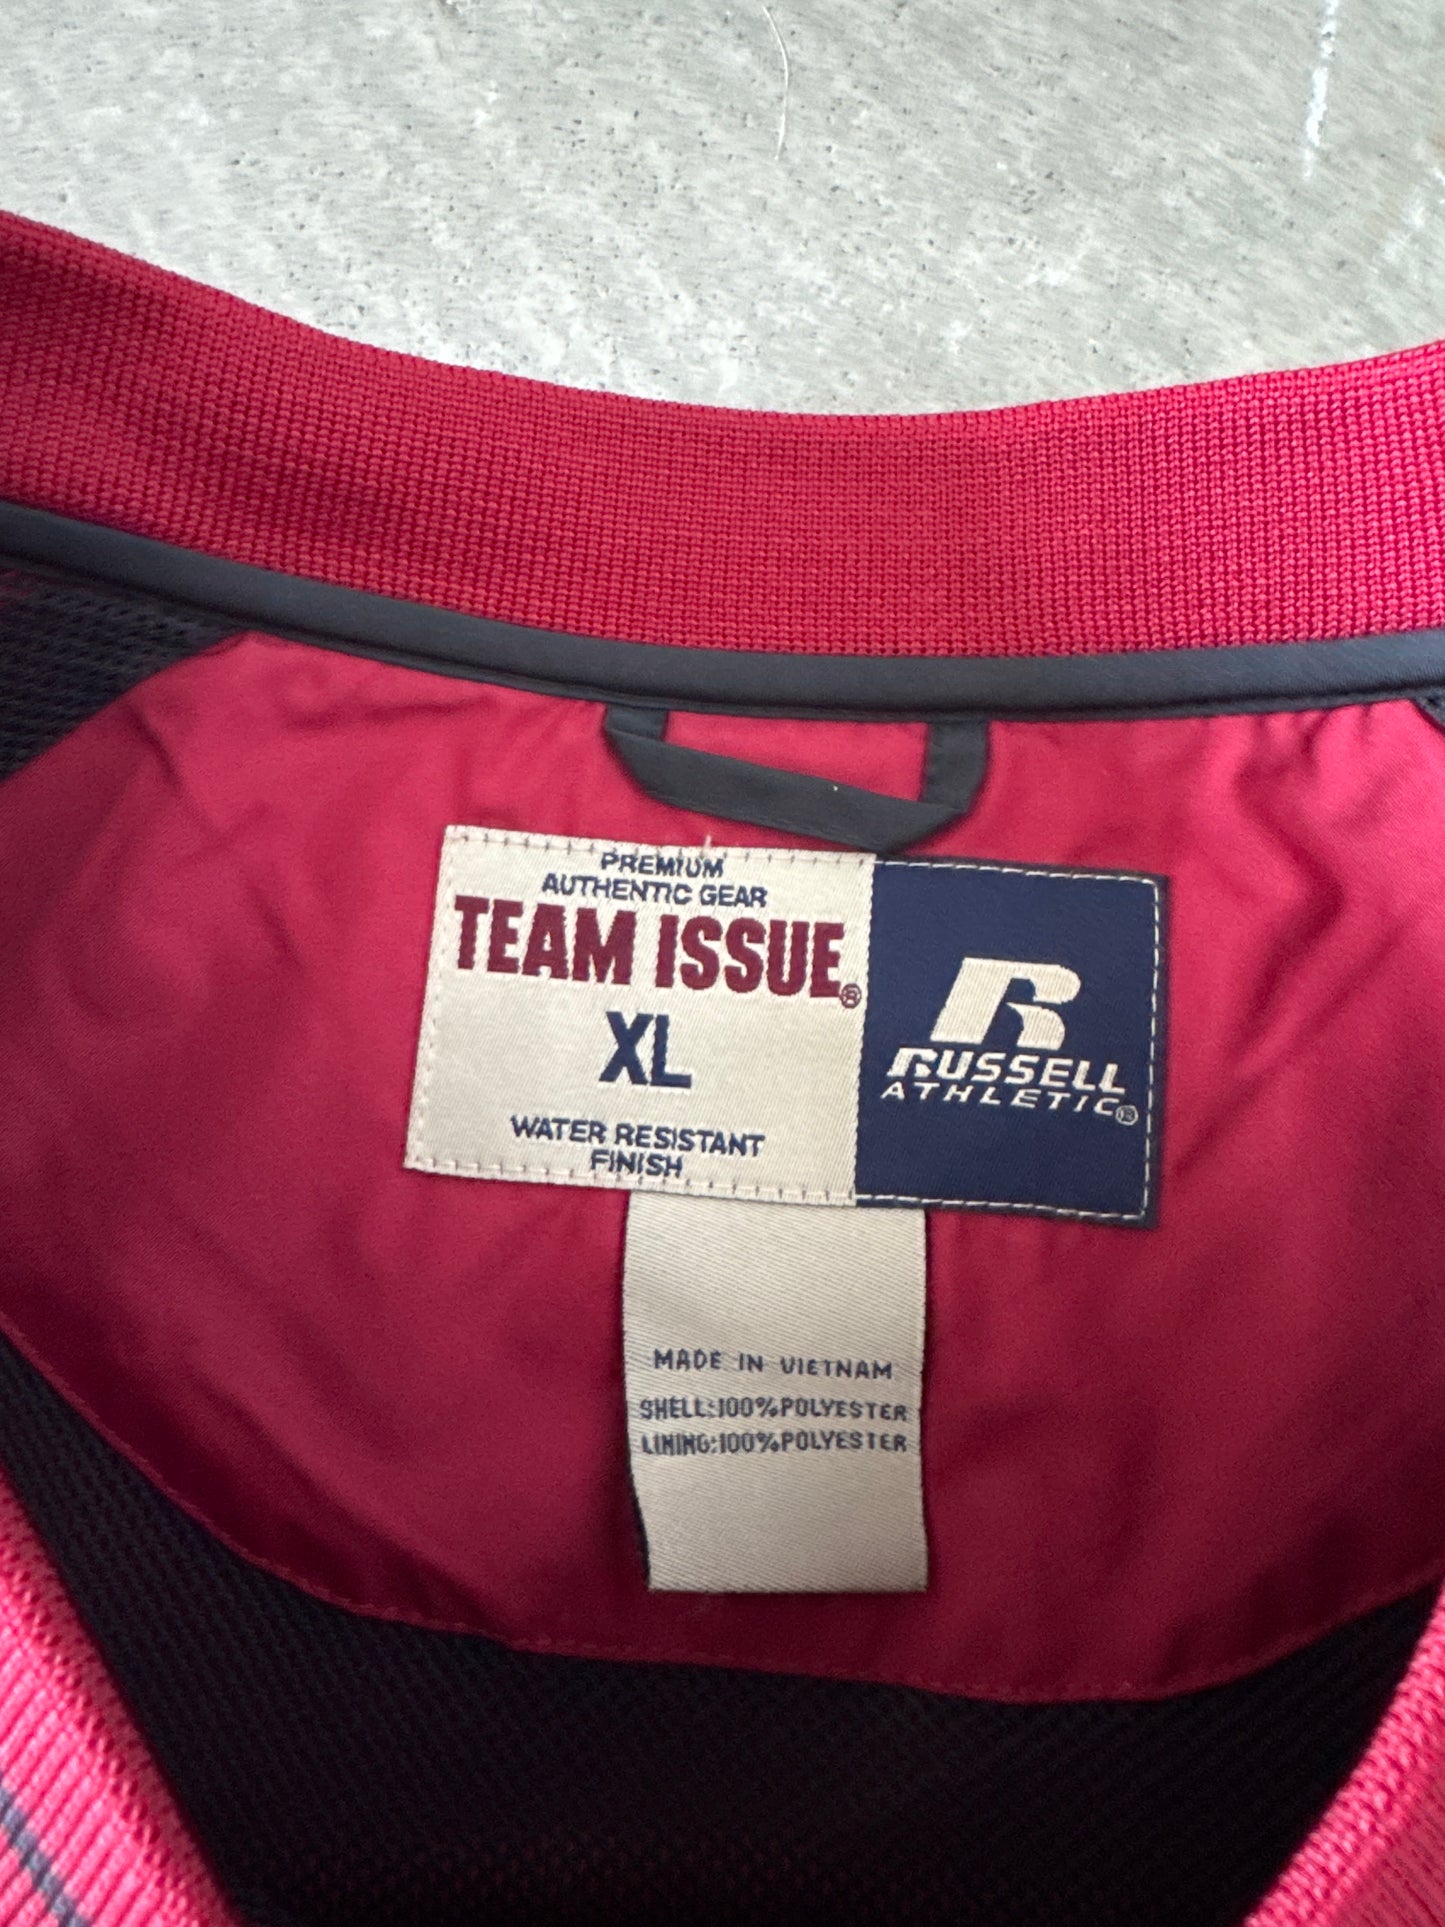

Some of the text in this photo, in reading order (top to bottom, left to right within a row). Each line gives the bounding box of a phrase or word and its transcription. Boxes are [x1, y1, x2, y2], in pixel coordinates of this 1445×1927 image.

[601, 851, 724, 877] PREMIUM
[542, 873, 768, 908] AUTHENTIC GEAR
[455, 894, 637, 985] TEAM
[599, 1011, 692, 1088] XL
[887, 1047, 1125, 1093] RUSSELL
[511, 1115, 766, 1157] WATER RESISTANT
[590, 1152, 683, 1177] FINISH
[653, 1348, 893, 1379] MADE IN VIETNAM
